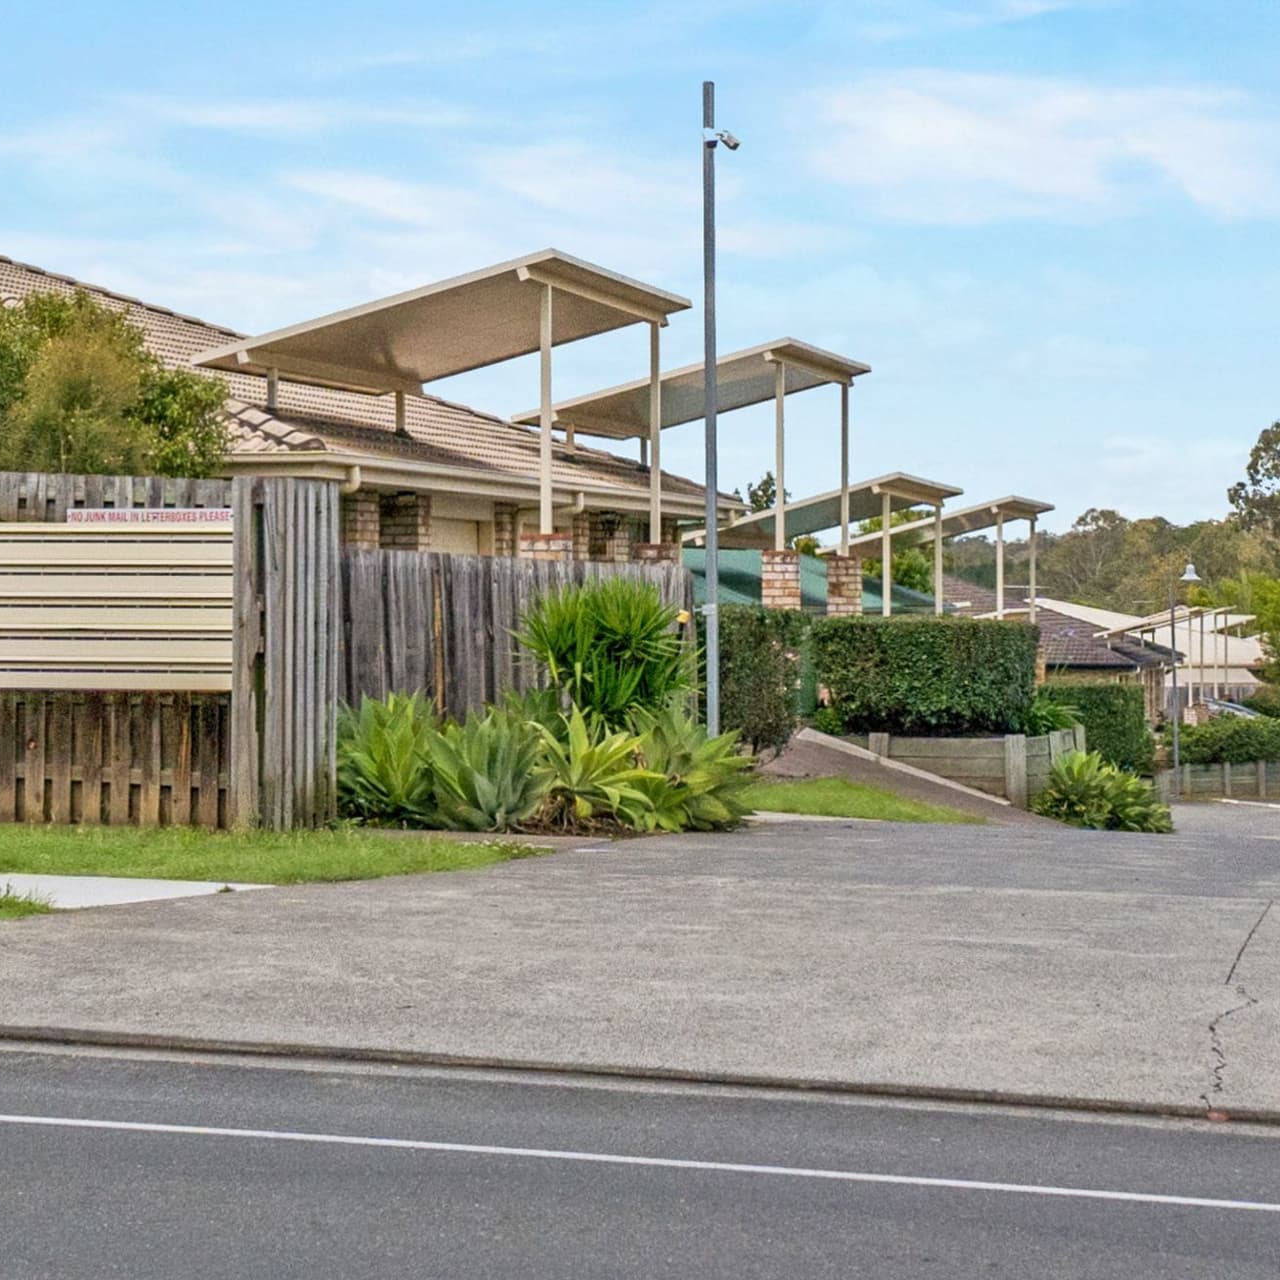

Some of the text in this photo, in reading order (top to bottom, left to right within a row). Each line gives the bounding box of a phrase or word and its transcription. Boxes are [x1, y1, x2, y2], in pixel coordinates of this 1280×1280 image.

[70, 511, 83, 522] NO
[86, 511, 106, 522] JUNK
[108, 511, 128, 522] MAIL
[130, 511, 139, 522] IN
[199, 510, 231, 522] PLEASE
